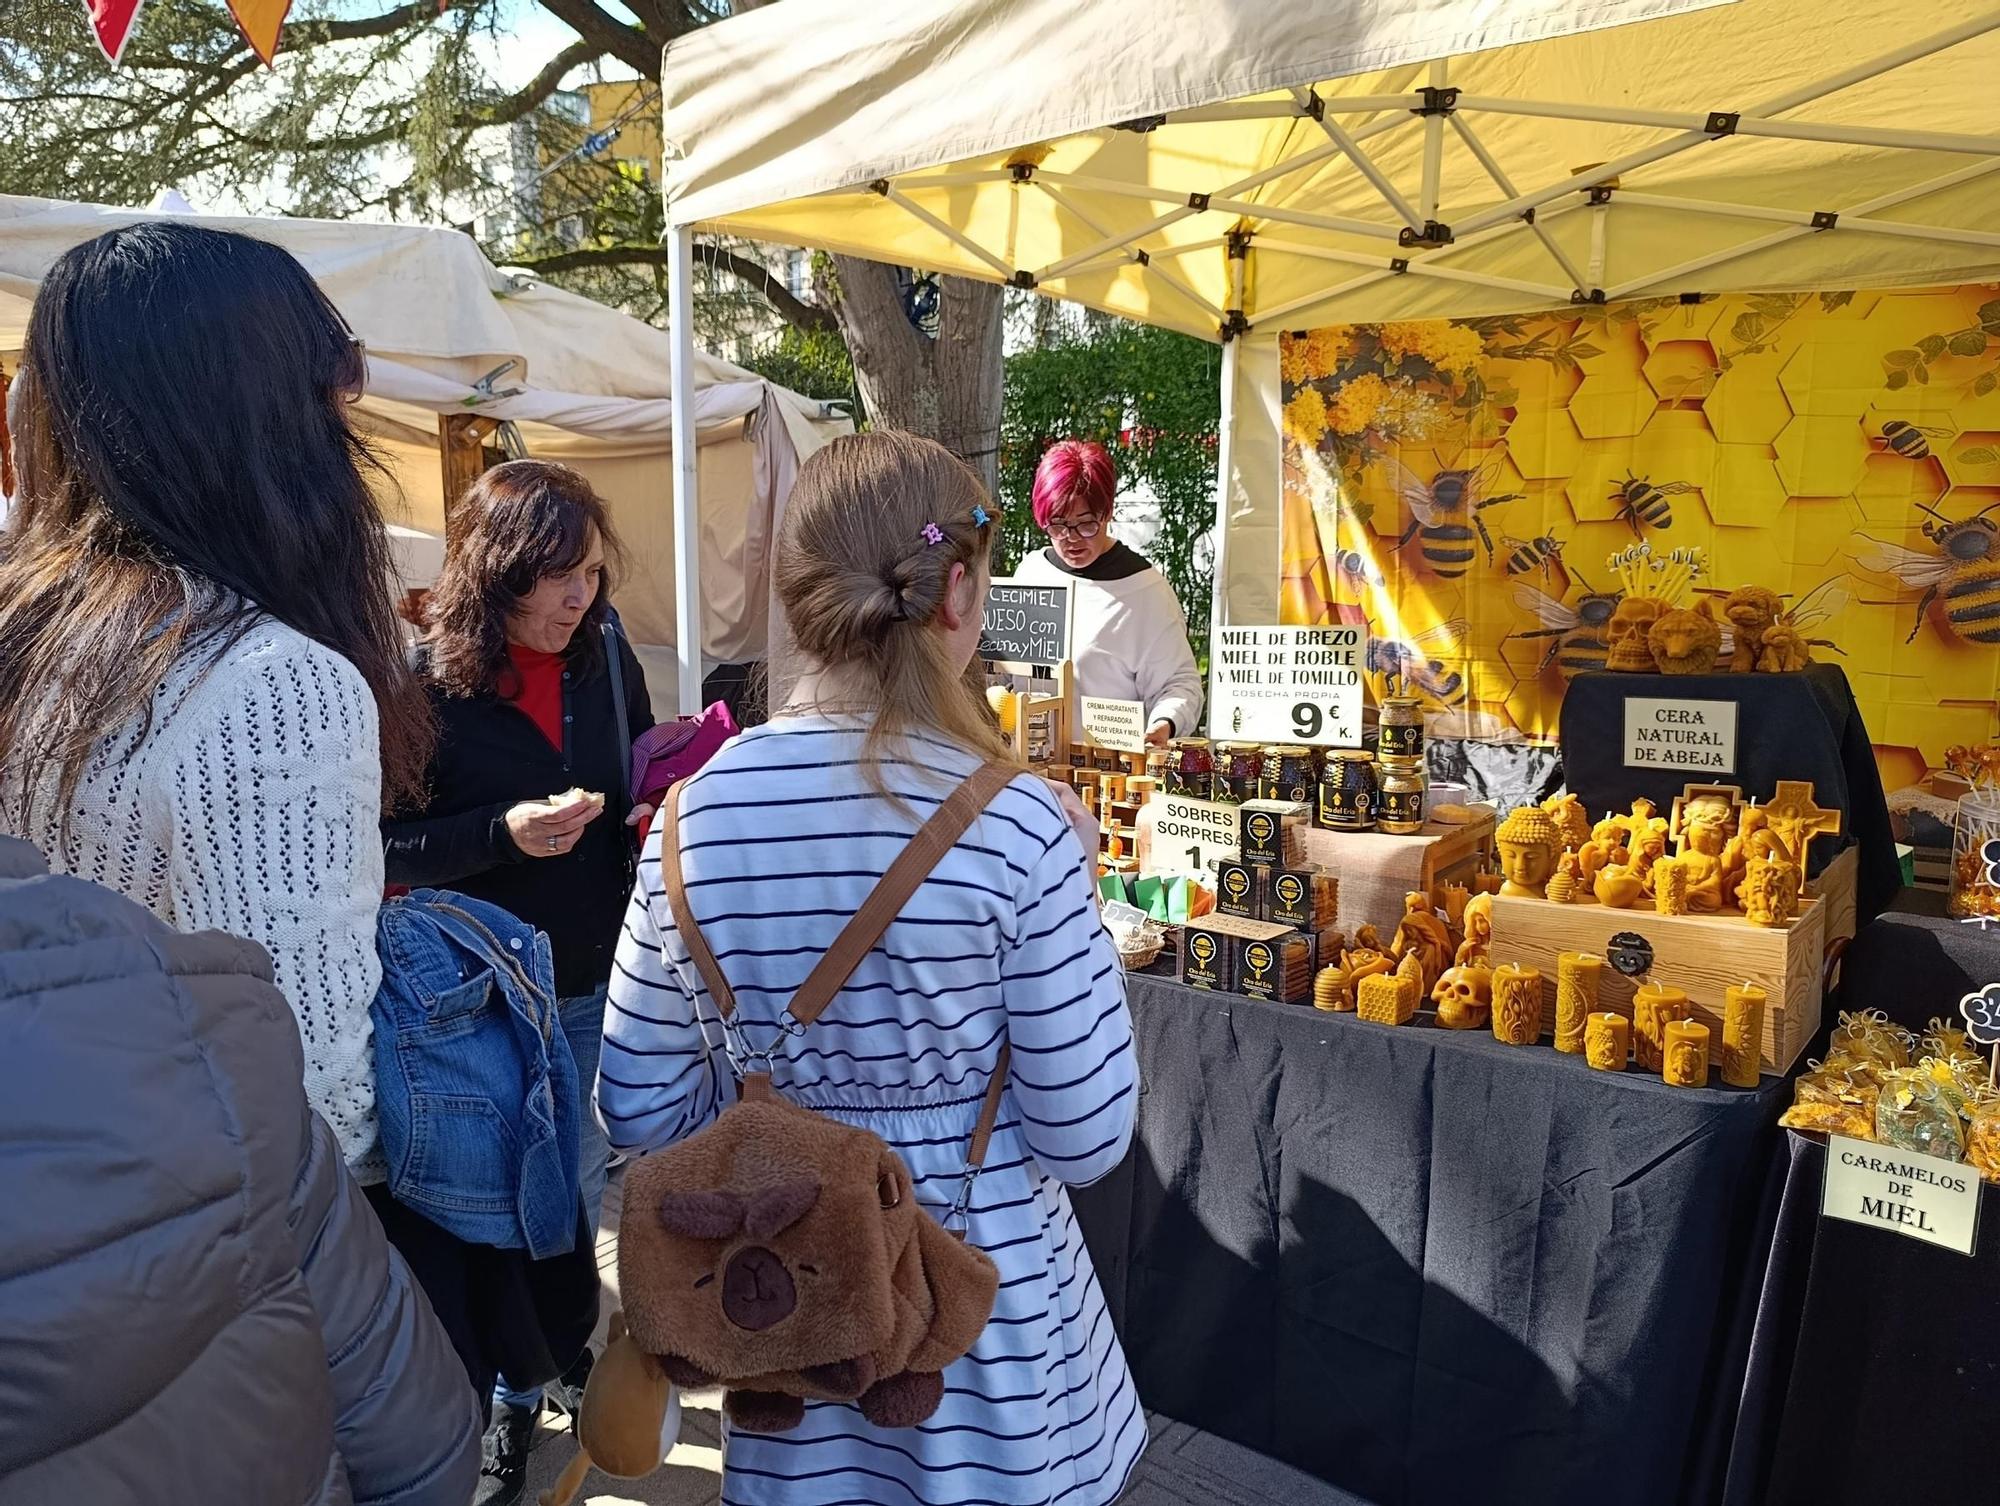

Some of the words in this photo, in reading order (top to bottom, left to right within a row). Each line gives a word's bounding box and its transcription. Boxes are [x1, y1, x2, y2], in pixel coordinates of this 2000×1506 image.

[1029, 621, 1057, 635] con
[1221, 631, 1262, 645] MIEL
[1268, 633, 1288, 646] DE
[1295, 630, 1358, 646] BREZO
[1221, 651, 1261, 665] MIEL
[1268, 652, 1287, 665] DE
[1294, 650, 1356, 666] ROBLE
[1218, 671, 1225, 683] Y
[1229, 669, 1263, 684] MIEL
[1268, 671, 1285, 684] DE
[1290, 670, 1358, 686] TOMILLO
[1232, 689, 1290, 698] COSECHA
[1294, 691, 1341, 699] PROPIA
[1086, 702, 1105, 710] CREMA
[1105, 704, 1139, 714] HIDRATANTE
[1655, 708, 1706, 725] CERA
[1097, 714, 1133, 725] REPARADORA
[1291, 702, 1323, 739] 9
[1328, 705, 1340, 720] €
[1637, 728, 1724, 746] NATURAL
[1634, 747, 1657, 761] DE
[1662, 749, 1725, 767] ABEJA
[1167, 803, 1233, 827] SOBRES
[1185, 846, 1201, 870] 1
[1841, 1152, 1966, 1193] CARAMELOS
[1888, 1181, 1913, 1198] DE
[1860, 1196, 1936, 1234] MIEL
